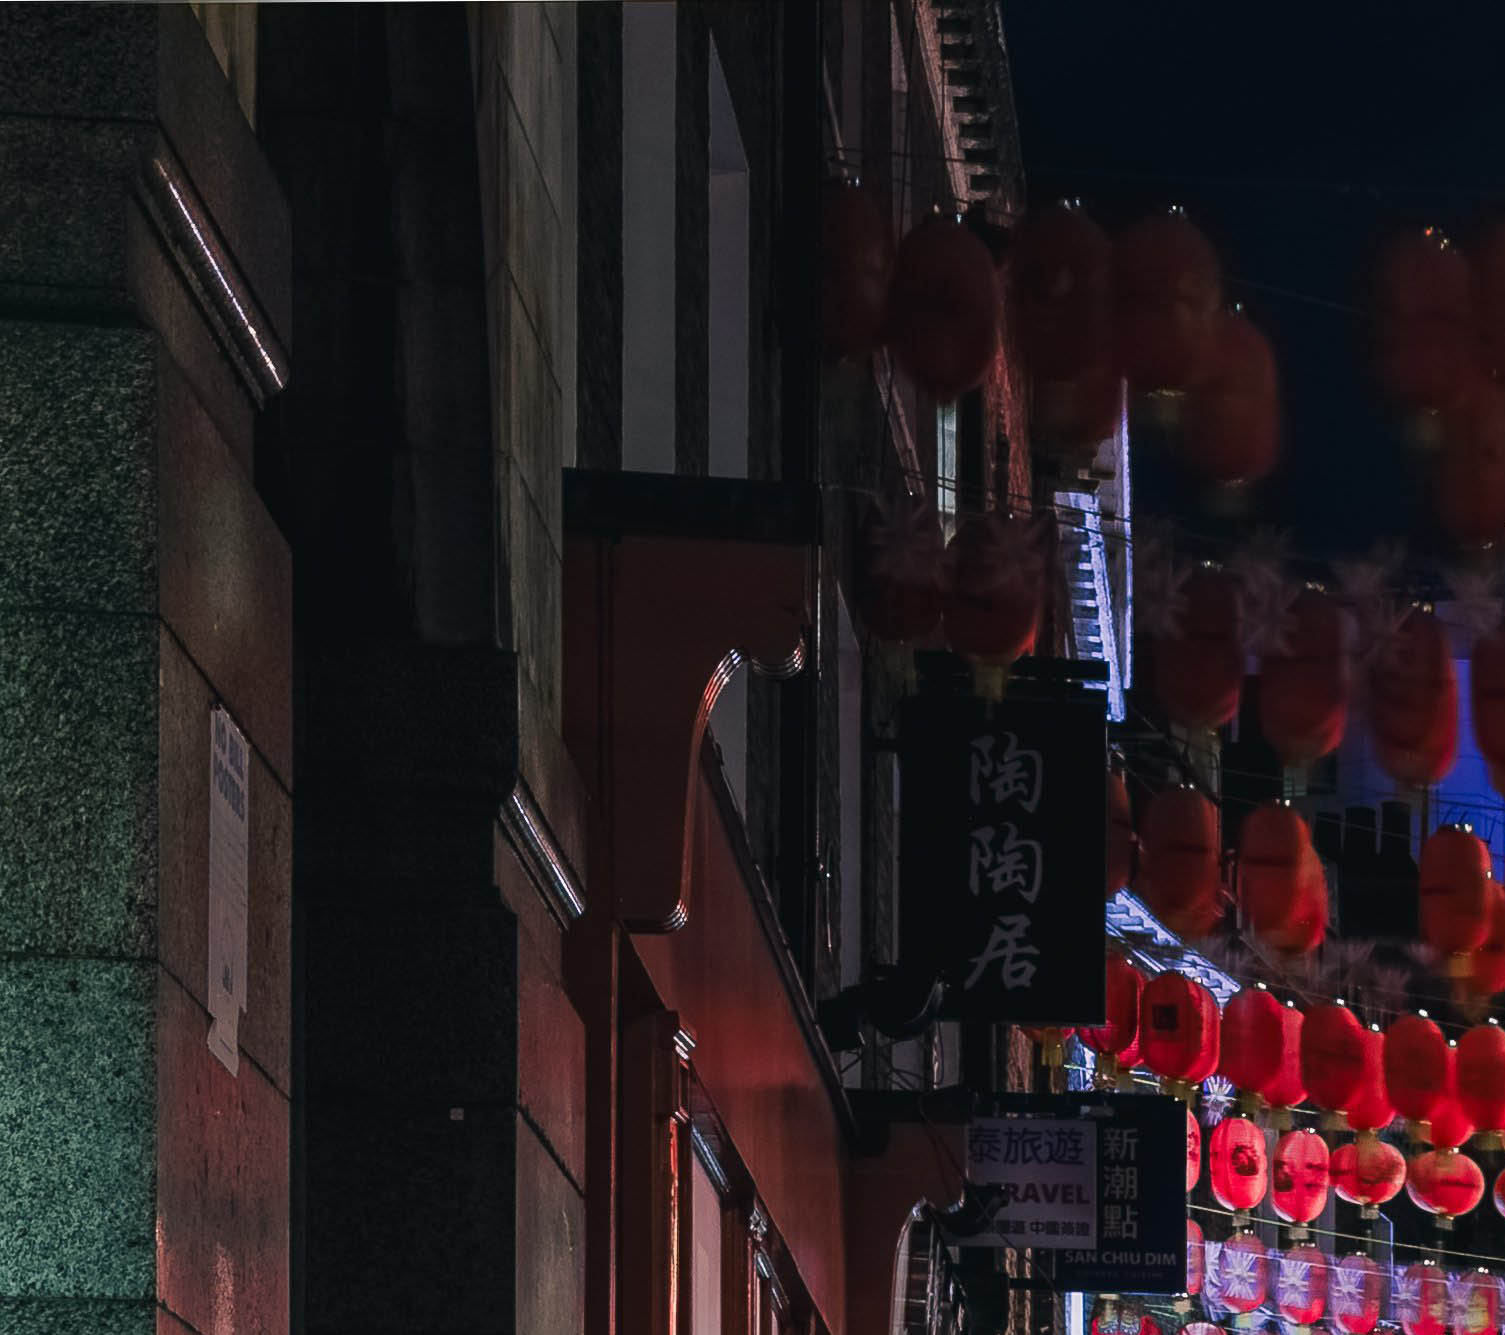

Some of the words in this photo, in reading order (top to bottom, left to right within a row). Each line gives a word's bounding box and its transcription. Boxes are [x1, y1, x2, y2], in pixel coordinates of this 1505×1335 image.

[963, 730, 1044, 992] 陶陶居
[1003, 1182, 1091, 1206] RAVEL
[1063, 1249, 1098, 1266] SAN
[1101, 1250, 1141, 1266] CHIU
[1144, 1251, 1178, 1267] DIM
